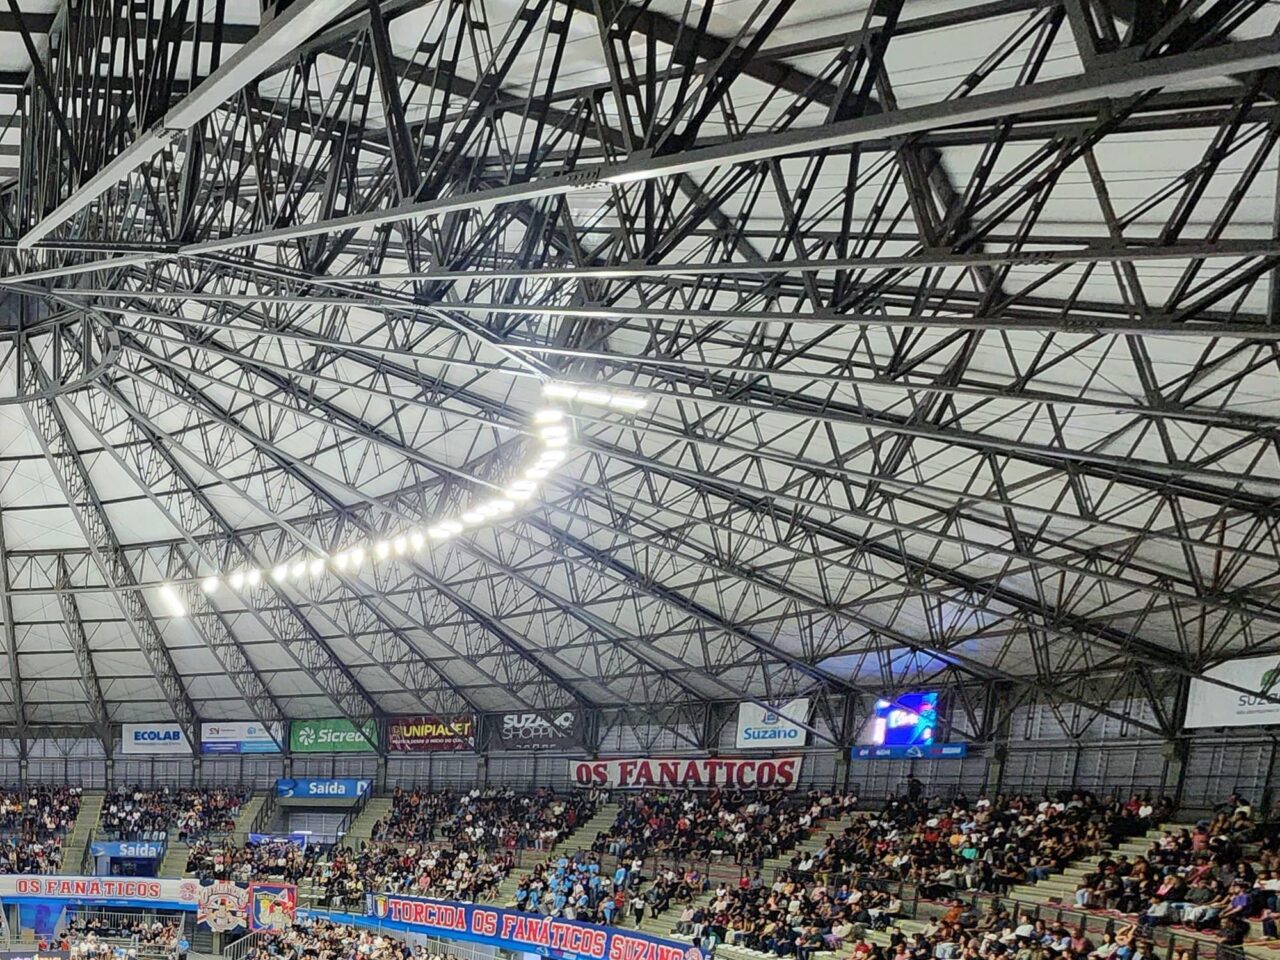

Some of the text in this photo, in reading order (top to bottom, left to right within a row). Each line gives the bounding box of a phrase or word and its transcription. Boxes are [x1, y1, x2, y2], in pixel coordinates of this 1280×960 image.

[134, 731, 181, 741] ECOLAB
[743, 727, 798, 740] Suzano
[576, 762, 607, 787] OS
[309, 781, 346, 795] Saída
[119, 843, 157, 857] Saída
[16, 877, 161, 898] OS FANÁTICOS
[389, 899, 467, 932] TORCIDA
[472, 909, 498, 937] OS
[501, 912, 607, 959] FANÁTICOS
